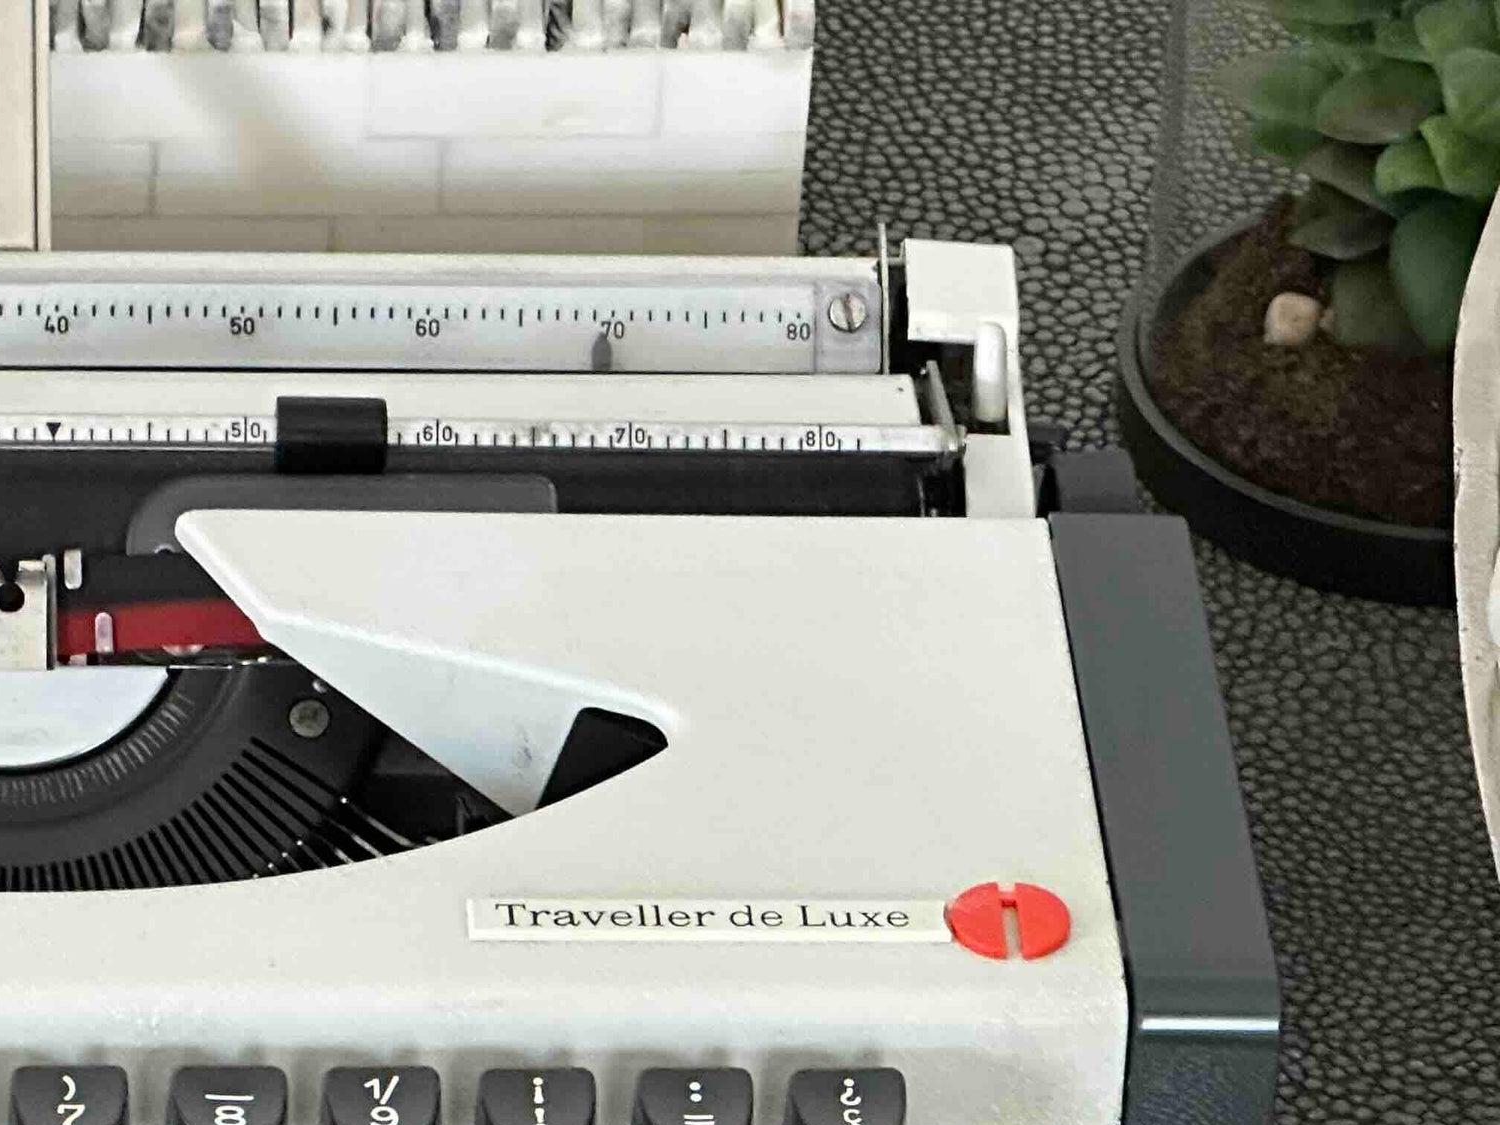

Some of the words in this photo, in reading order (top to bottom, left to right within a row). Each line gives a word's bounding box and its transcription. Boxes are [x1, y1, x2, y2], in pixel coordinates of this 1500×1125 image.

[43, 315, 70, 335] 40
[229, 316, 255, 336] 50
[414, 318, 441, 338] 60
[600, 320, 625, 340] 70
[786, 322, 811, 341] 80
[495, 902, 716, 929] Traveller
[728, 904, 784, 929] de
[798, 904, 911, 929] Luxe
